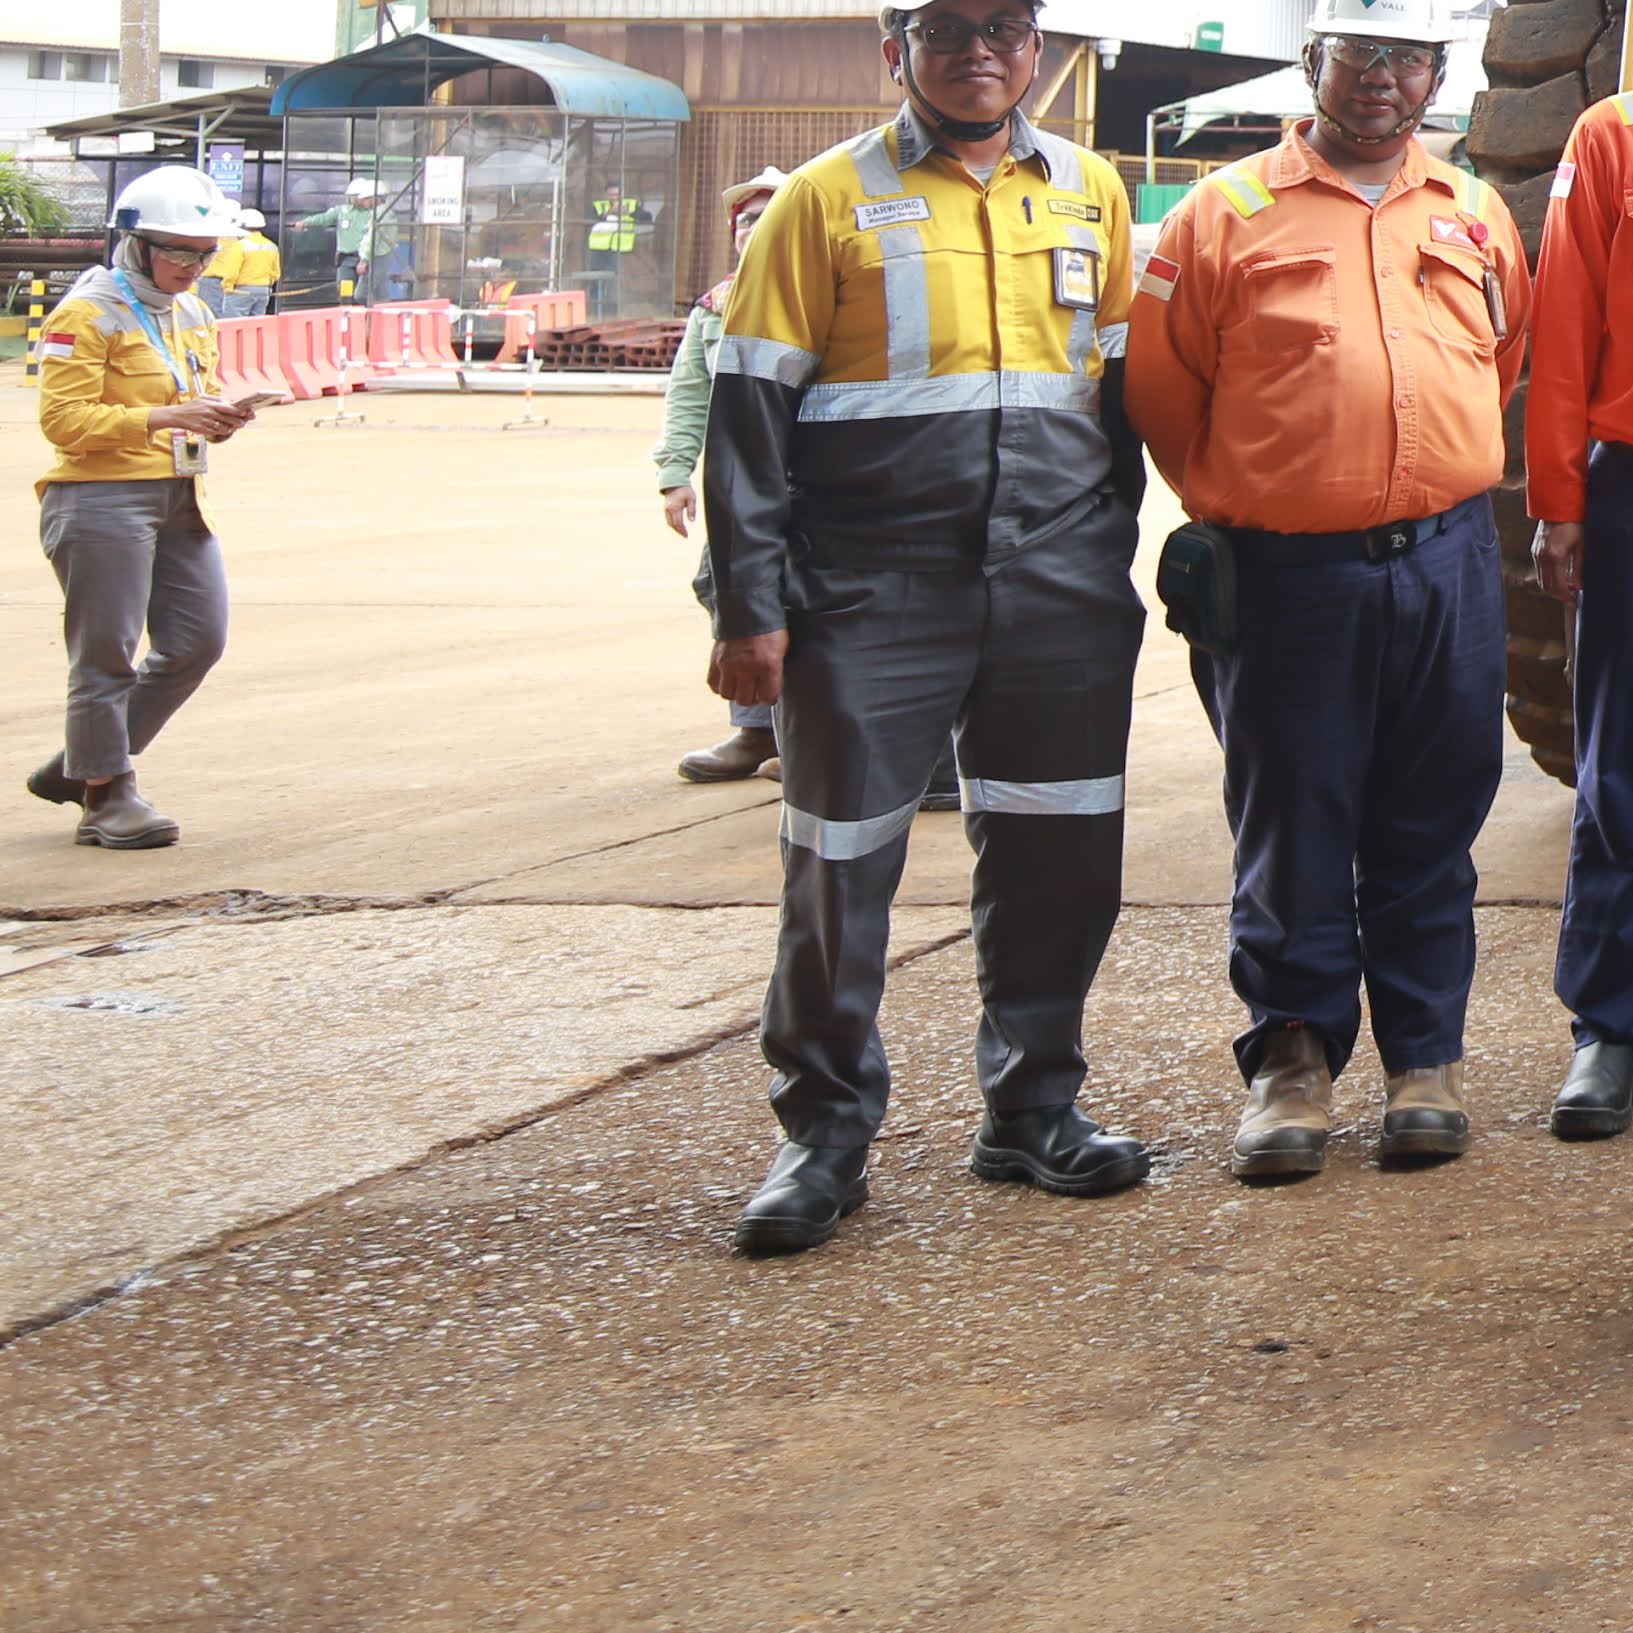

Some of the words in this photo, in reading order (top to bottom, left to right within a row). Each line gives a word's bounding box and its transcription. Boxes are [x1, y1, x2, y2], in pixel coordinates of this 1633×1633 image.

[428, 197, 459, 206] SMOKING
[865, 200, 920, 217] SARWONO
[433, 209, 451, 218] AREA
